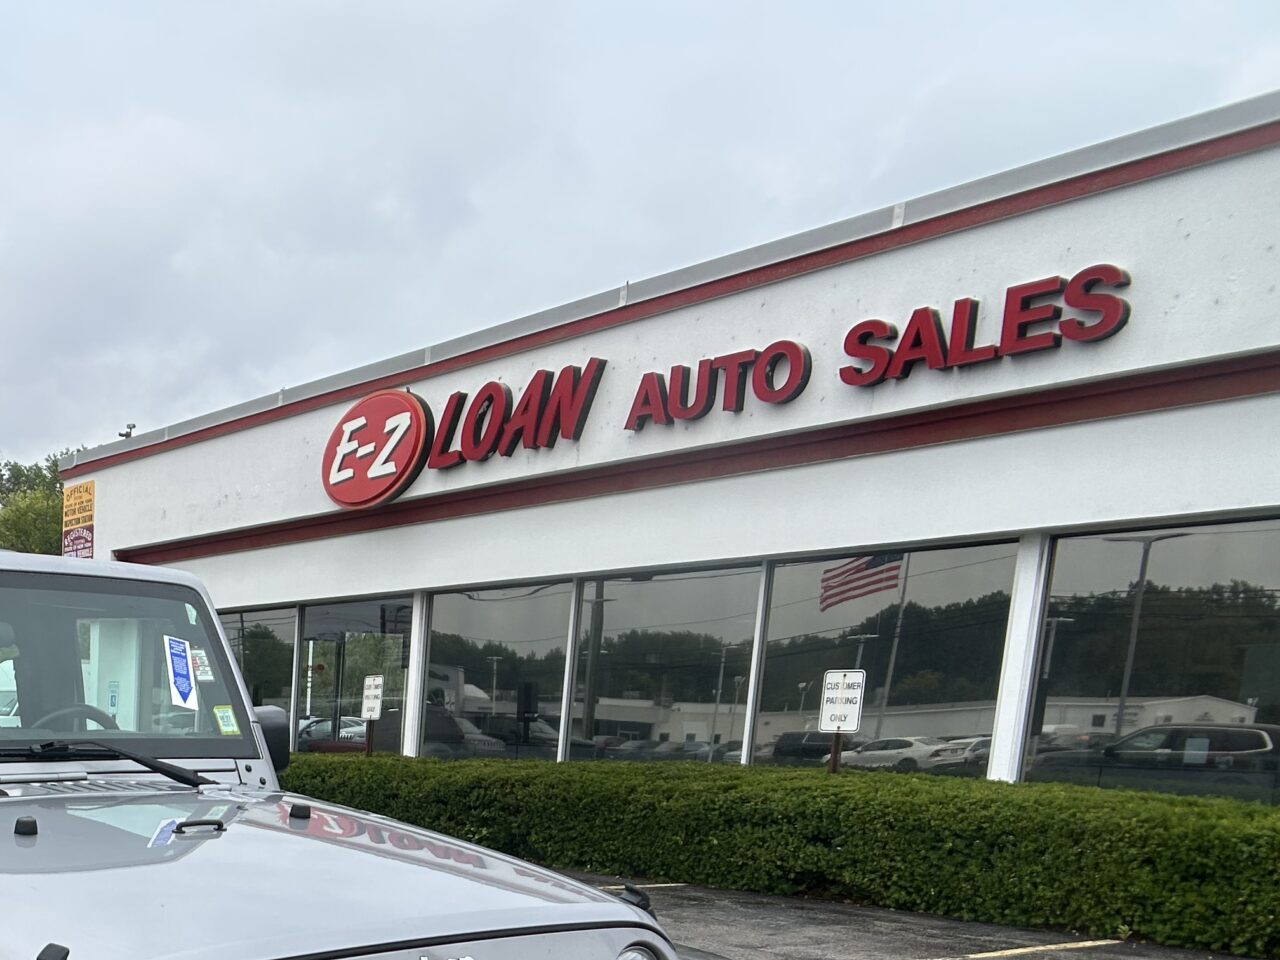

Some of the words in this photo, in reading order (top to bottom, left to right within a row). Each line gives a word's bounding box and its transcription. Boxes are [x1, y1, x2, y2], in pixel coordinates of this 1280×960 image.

[329, 411, 413, 486] E-Z
[428, 357, 607, 470] LOAN
[624, 340, 812, 431] AUTO
[839, 263, 1132, 388] SALES
[66, 485, 92, 502] OFFICIAL
[77, 503, 92, 515] VEHICLE
[65, 528, 92, 545] REGISTERED
[826, 682, 861, 690] CUSOMER
[830, 713, 848, 722] ONLY
